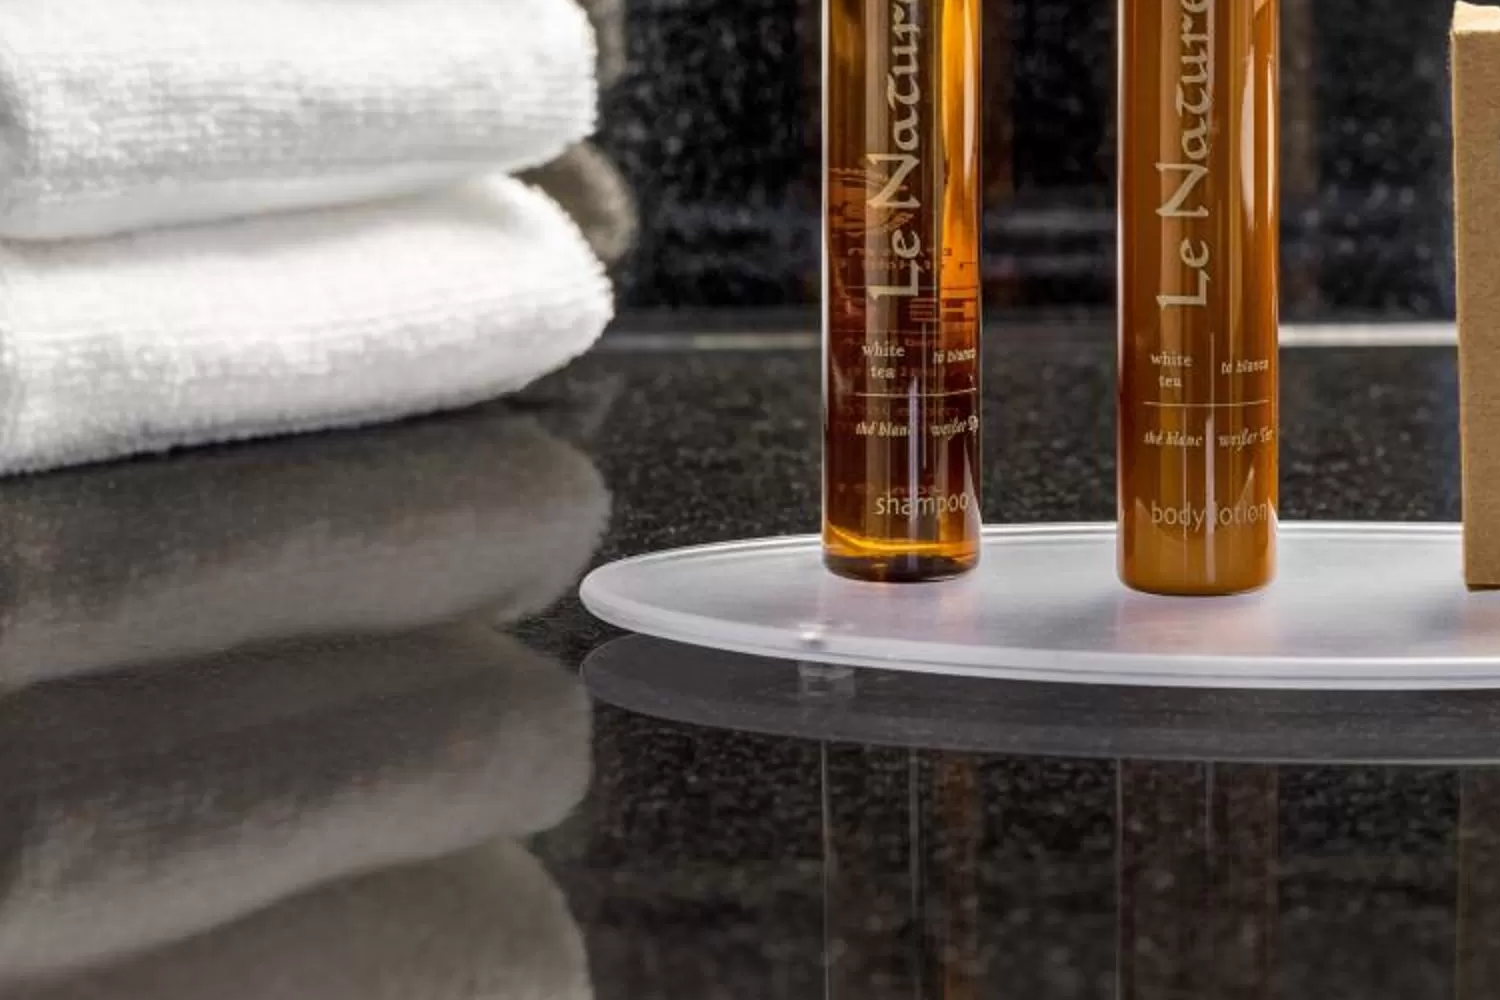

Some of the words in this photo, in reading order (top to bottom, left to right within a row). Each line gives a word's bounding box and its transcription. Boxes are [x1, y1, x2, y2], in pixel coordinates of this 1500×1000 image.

[866, 230, 922, 301] Le
[1156, 238, 1211, 311] Le
[862, 340, 906, 358] white
[1151, 350, 1194, 367] white
[871, 365, 896, 379] tea
[1158, 375, 1183, 388] tea
[875, 493, 970, 519] shampoo
[1151, 501, 1206, 532] body
